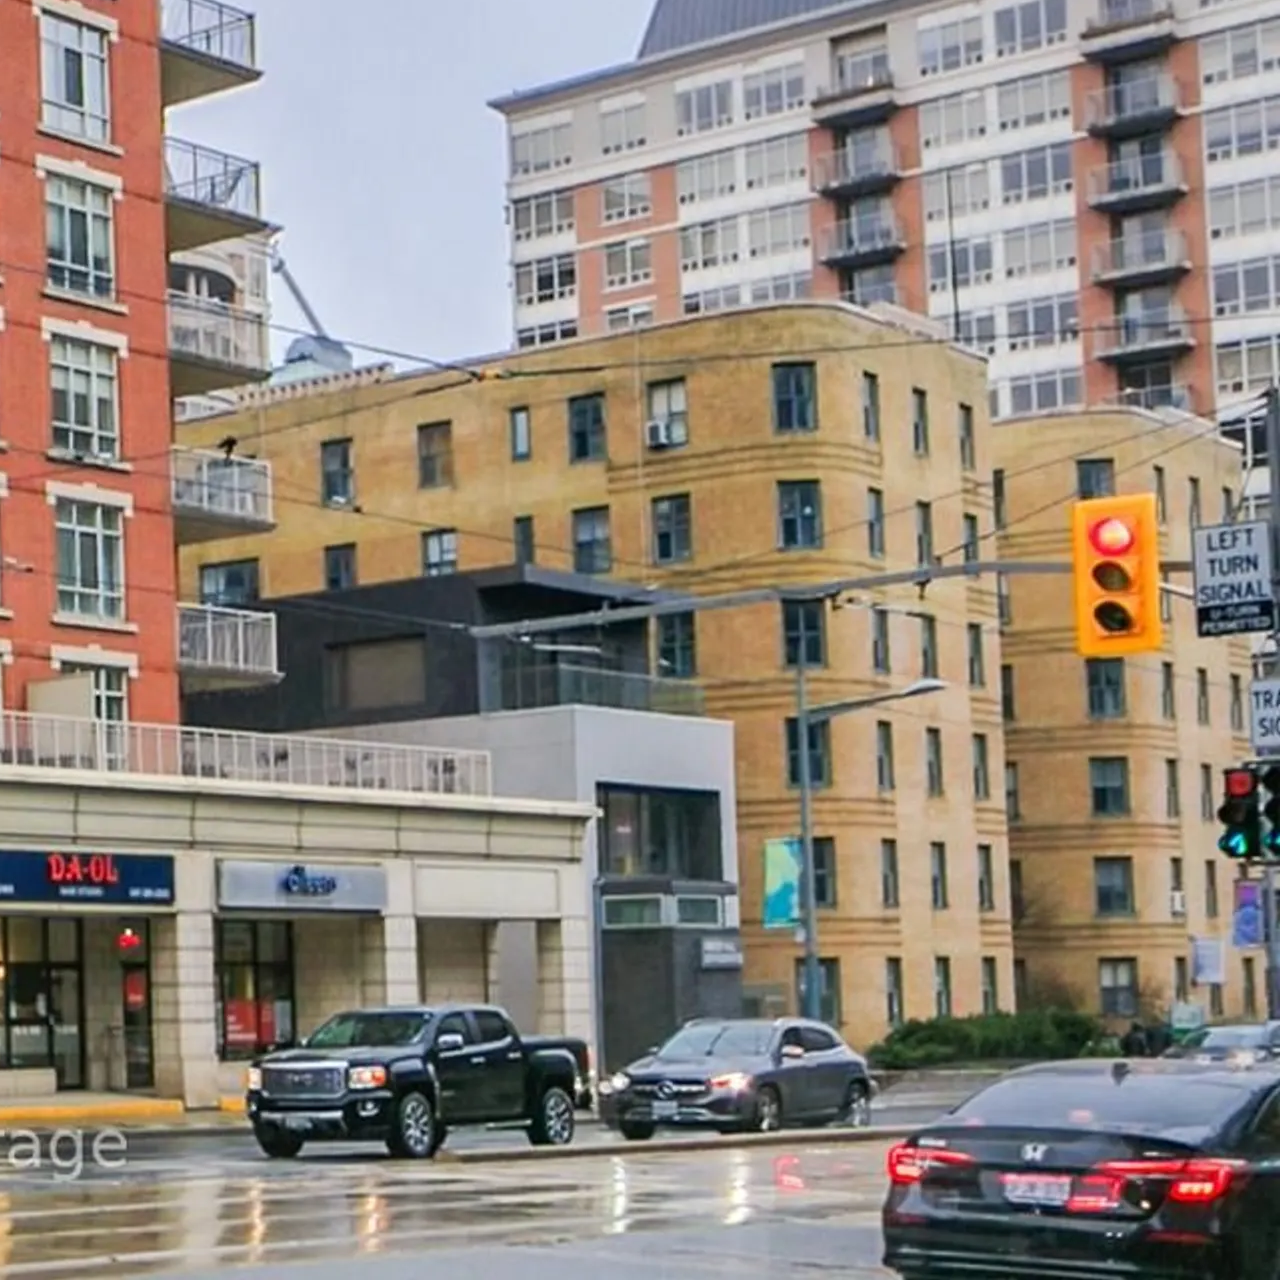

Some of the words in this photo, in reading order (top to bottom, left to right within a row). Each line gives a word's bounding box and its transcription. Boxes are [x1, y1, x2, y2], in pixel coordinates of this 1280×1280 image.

[1205, 528, 1254, 552] LEFT
[1206, 553, 1260, 577] TURN
[1199, 580, 1269, 605] SIGNAL
[47, 853, 119, 883] DA-OL
